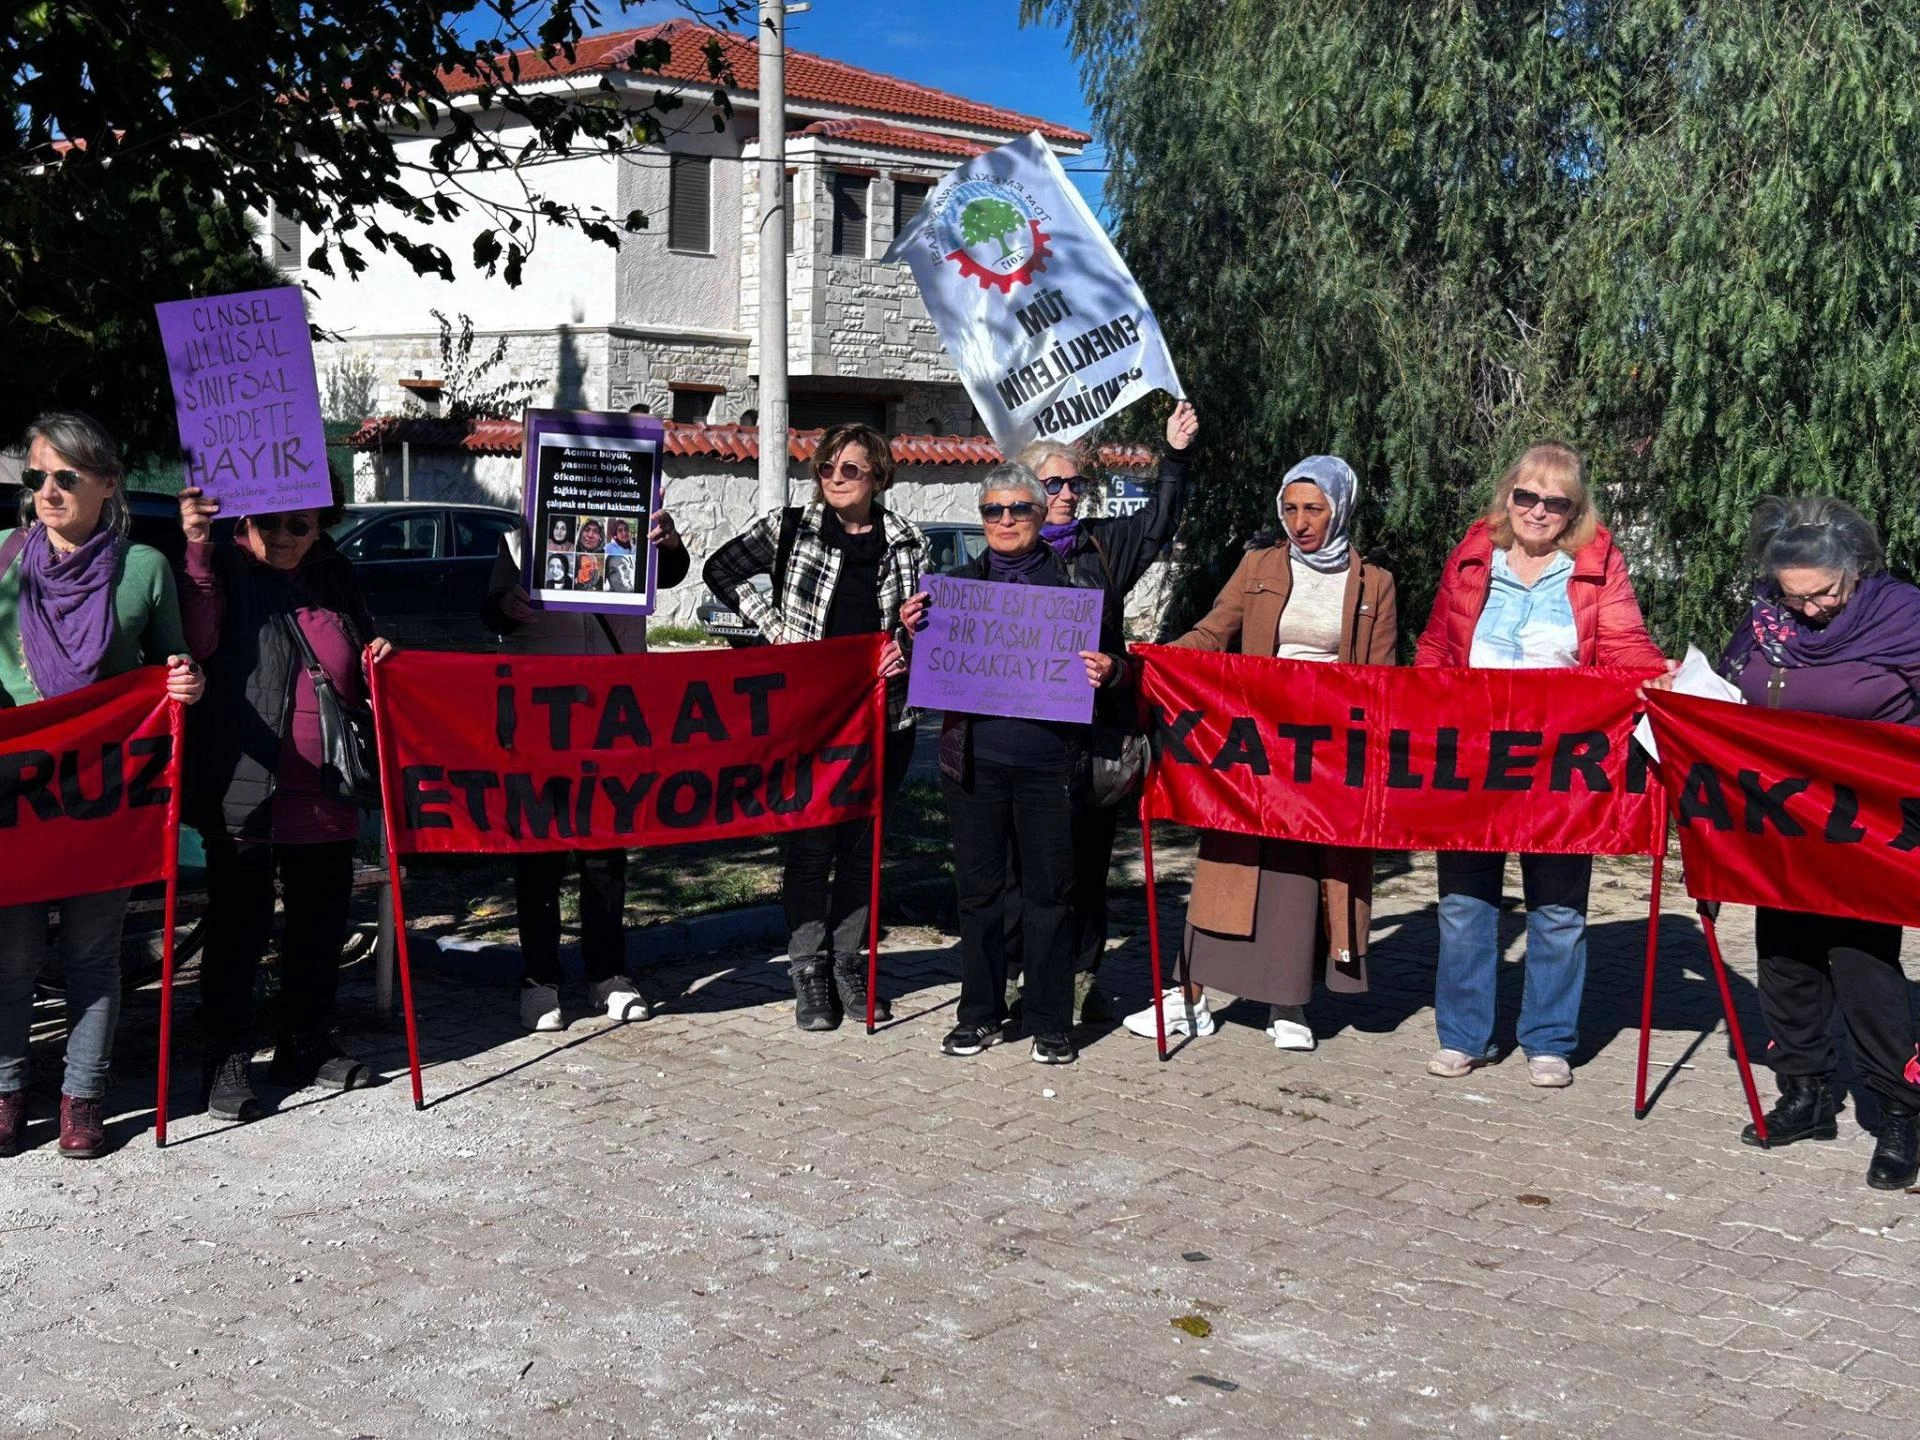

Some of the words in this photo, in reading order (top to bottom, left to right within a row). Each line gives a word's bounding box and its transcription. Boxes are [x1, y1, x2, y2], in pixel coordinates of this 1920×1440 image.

[193, 298, 282, 332] CİNSEL
[184, 328, 291, 372] ULUSAL
[184, 368, 298, 411] SINIFSAL
[189, 436, 314, 486] HAYIR
[563, 448, 597, 457] Acımız
[577, 501, 586, 509] en
[587, 501, 606, 510] temel
[949, 612, 976, 645] BİR
[928, 647, 1071, 683] SOKAKTAYIZ
[495, 664, 786, 750] İTAAT
[403, 744, 872, 839] ETMİYORUZ
